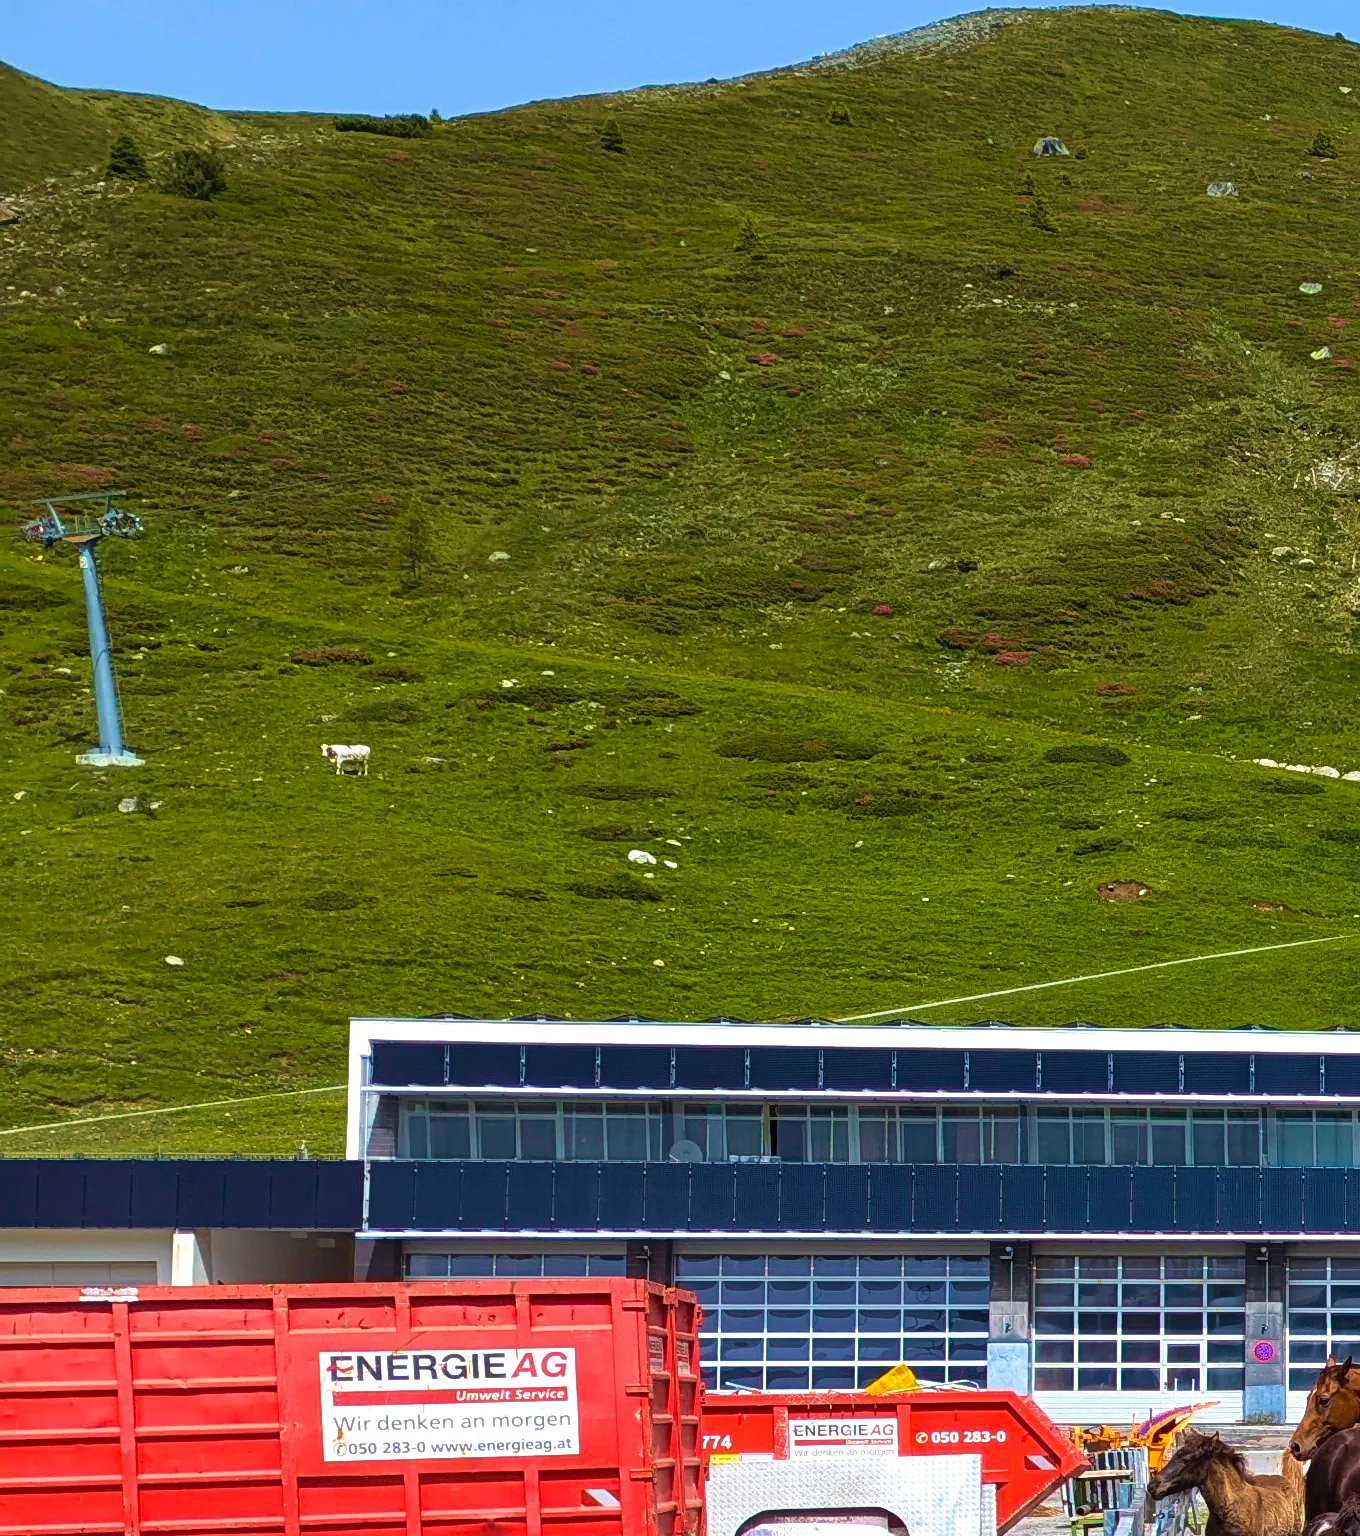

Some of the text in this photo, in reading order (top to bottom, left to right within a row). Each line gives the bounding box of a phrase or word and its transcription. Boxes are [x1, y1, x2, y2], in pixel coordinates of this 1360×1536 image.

[328, 1351, 567, 1381] ENERGIE AG
[456, 1389, 565, 1401] Umwelt Service
[333, 1414, 571, 1431] Wir denken an morgen
[793, 1423, 894, 1437] ENERGIE AG
[931, 1426, 1006, 1444] 050 283-0
[348, 1438, 572, 1455] 050 283-0 www.energieag.at
